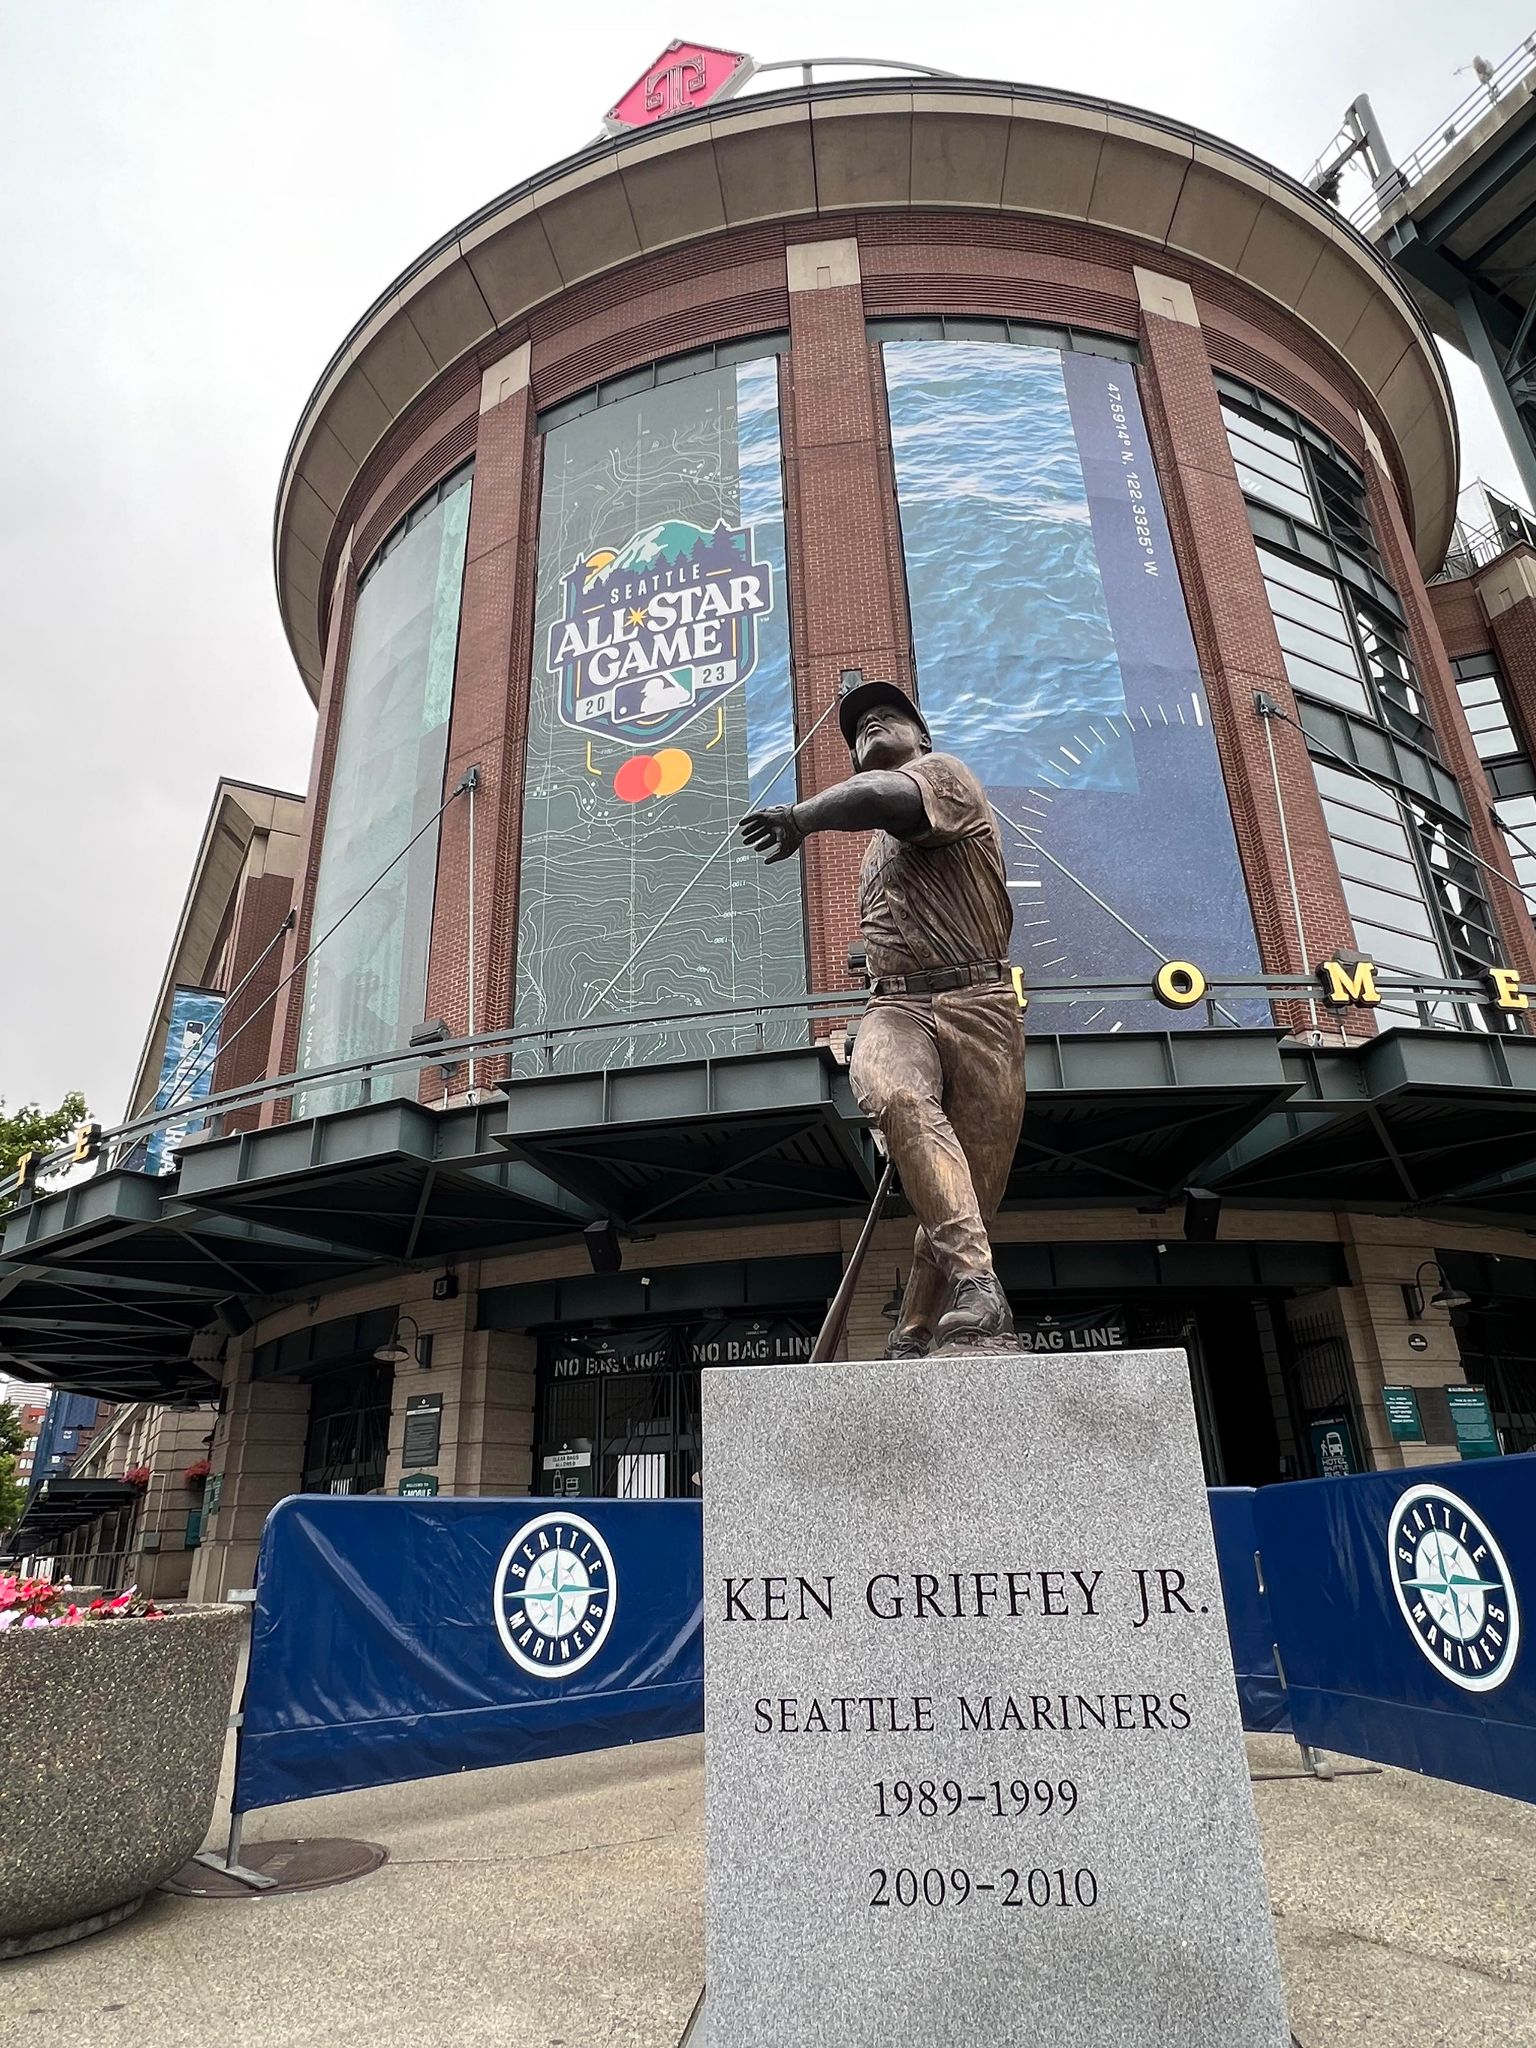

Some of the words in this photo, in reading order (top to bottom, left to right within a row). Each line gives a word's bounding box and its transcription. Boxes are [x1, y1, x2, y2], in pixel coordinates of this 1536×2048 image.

[645, 53, 706, 119] T
[611, 564, 700, 604] SEATTLE
[1144, 561, 1159, 576] W
[554, 607, 639, 664] ALL
[647, 575, 765, 632] STAR
[588, 620, 723, 686] GAME
[585, 695, 605, 716] 20
[702, 666, 725, 683] 23
[693, 1343, 720, 1362] NO
[727, 1340, 769, 1361] BAG
[1018, 1331, 1064, 1350] BAG
[1069, 1327, 1123, 1349] LINE
[554, 1358, 579, 1377] NO
[511, 1527, 602, 1578] SEATTLE
[1398, 1503, 1486, 1564] SEATTLE
[722, 1576, 835, 1622] KEN
[866, 1571, 1103, 1620] GRIFFEY
[1131, 1569, 1209, 1628] JR.
[509, 1604, 603, 1661] MARINERS
[1412, 1602, 1505, 1670] MARINERS
[754, 1697, 935, 1734] SEATTLE
[959, 1693, 1192, 1732] MARINERS
